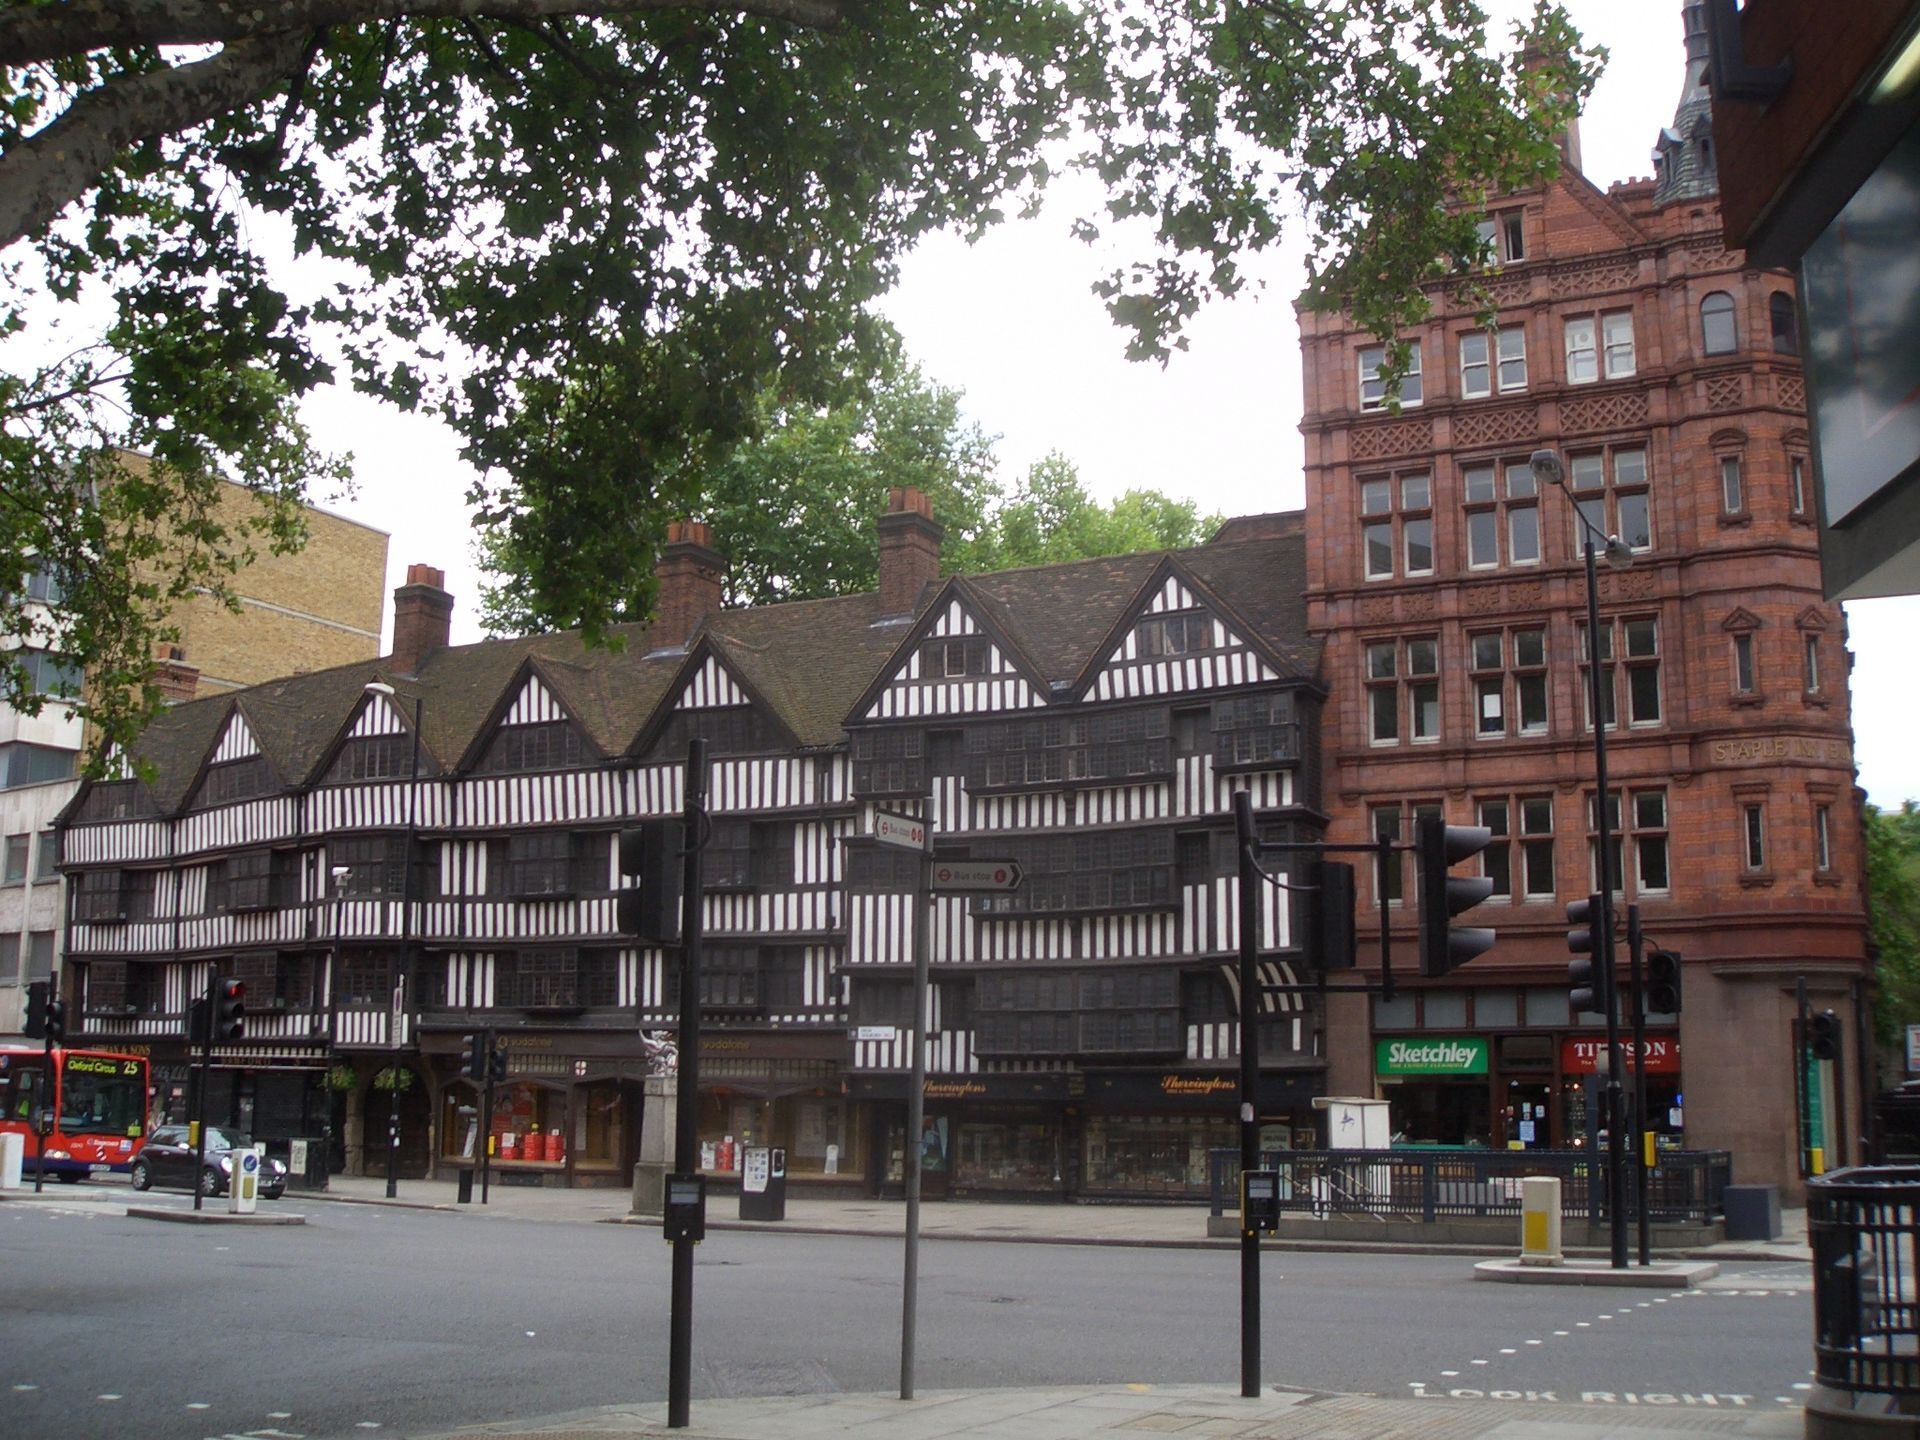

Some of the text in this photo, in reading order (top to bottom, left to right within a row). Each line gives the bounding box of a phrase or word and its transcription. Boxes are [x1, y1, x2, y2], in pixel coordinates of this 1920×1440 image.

[1715, 739, 1785, 761] STAPLE
[511, 1036, 553, 1049] vodafone
[703, 1038, 751, 1050] vodafone
[1389, 1042, 1478, 1068] Sketchley
[68, 1060, 139, 1075] Oxford Circus 25
[1414, 1388, 1754, 1406] LOOK RIGHT
